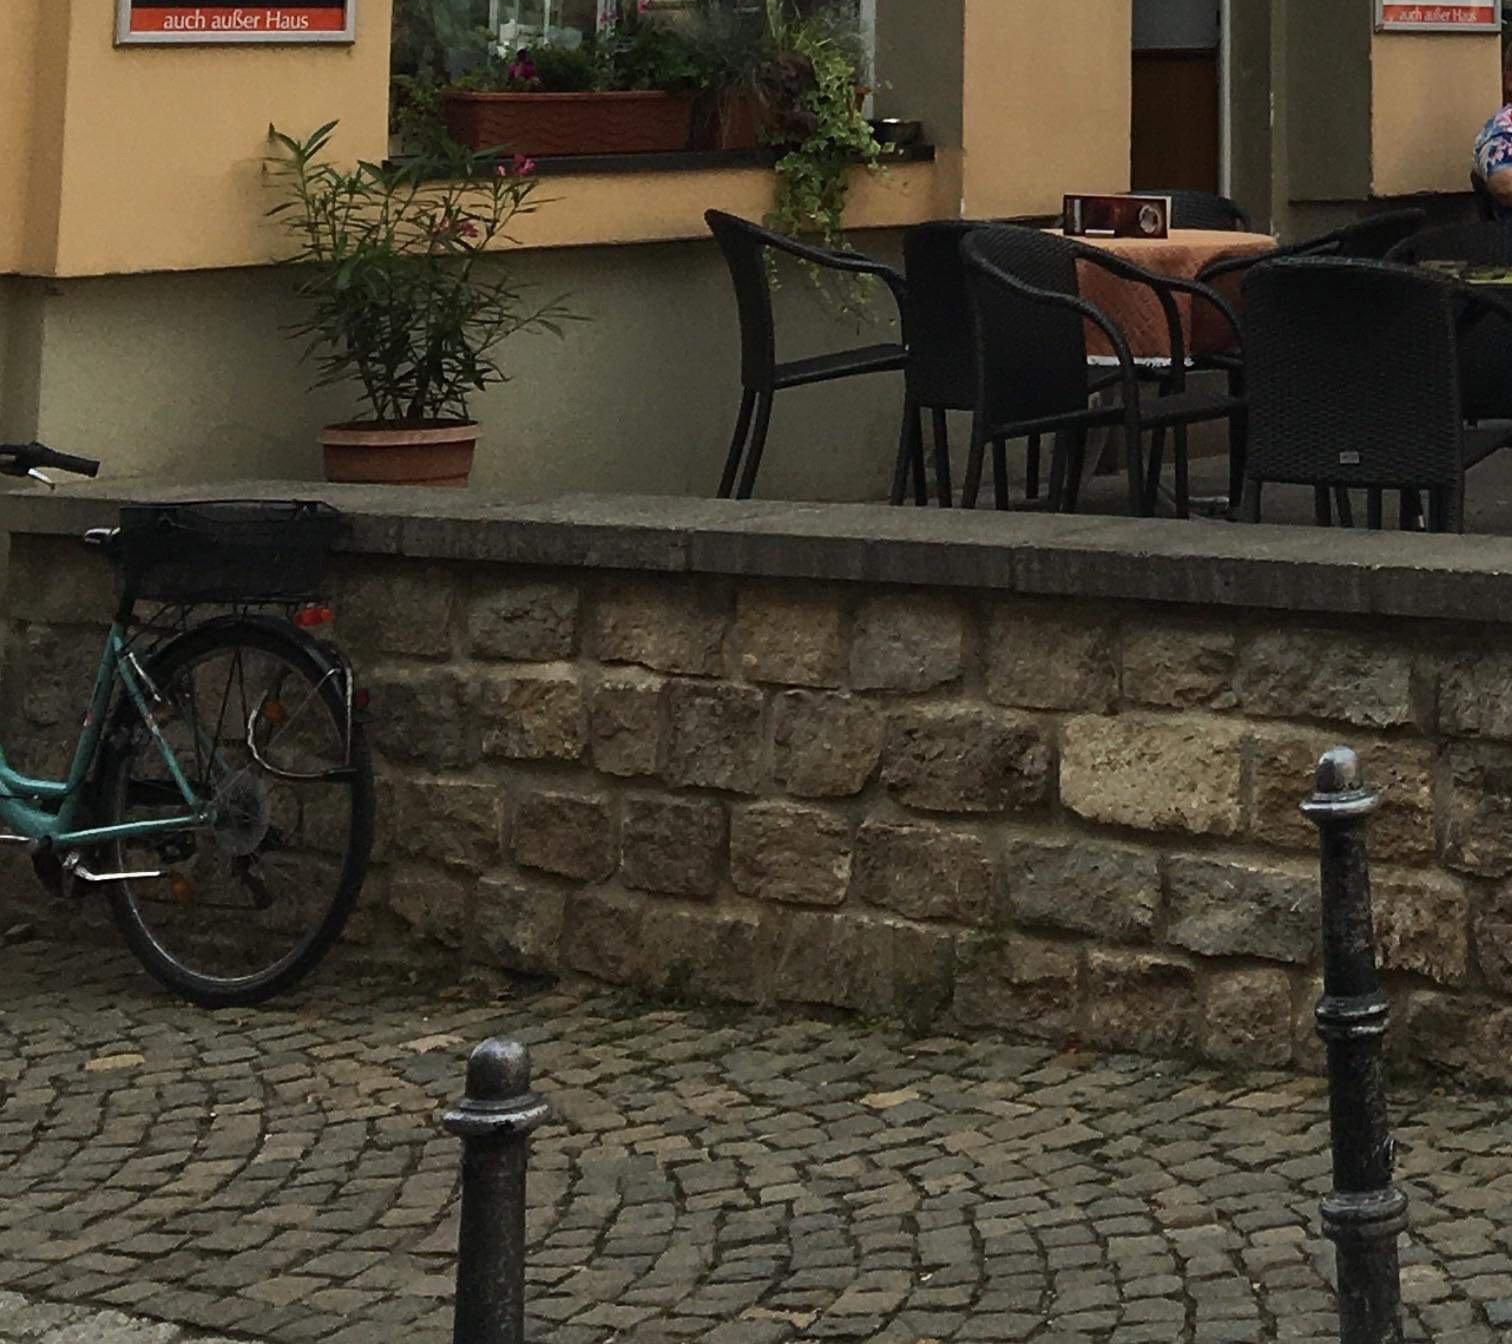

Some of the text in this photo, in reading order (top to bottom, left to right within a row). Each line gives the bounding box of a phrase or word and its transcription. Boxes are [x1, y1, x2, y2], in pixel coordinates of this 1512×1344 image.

[163, 8, 309, 31] auch außer Haus
